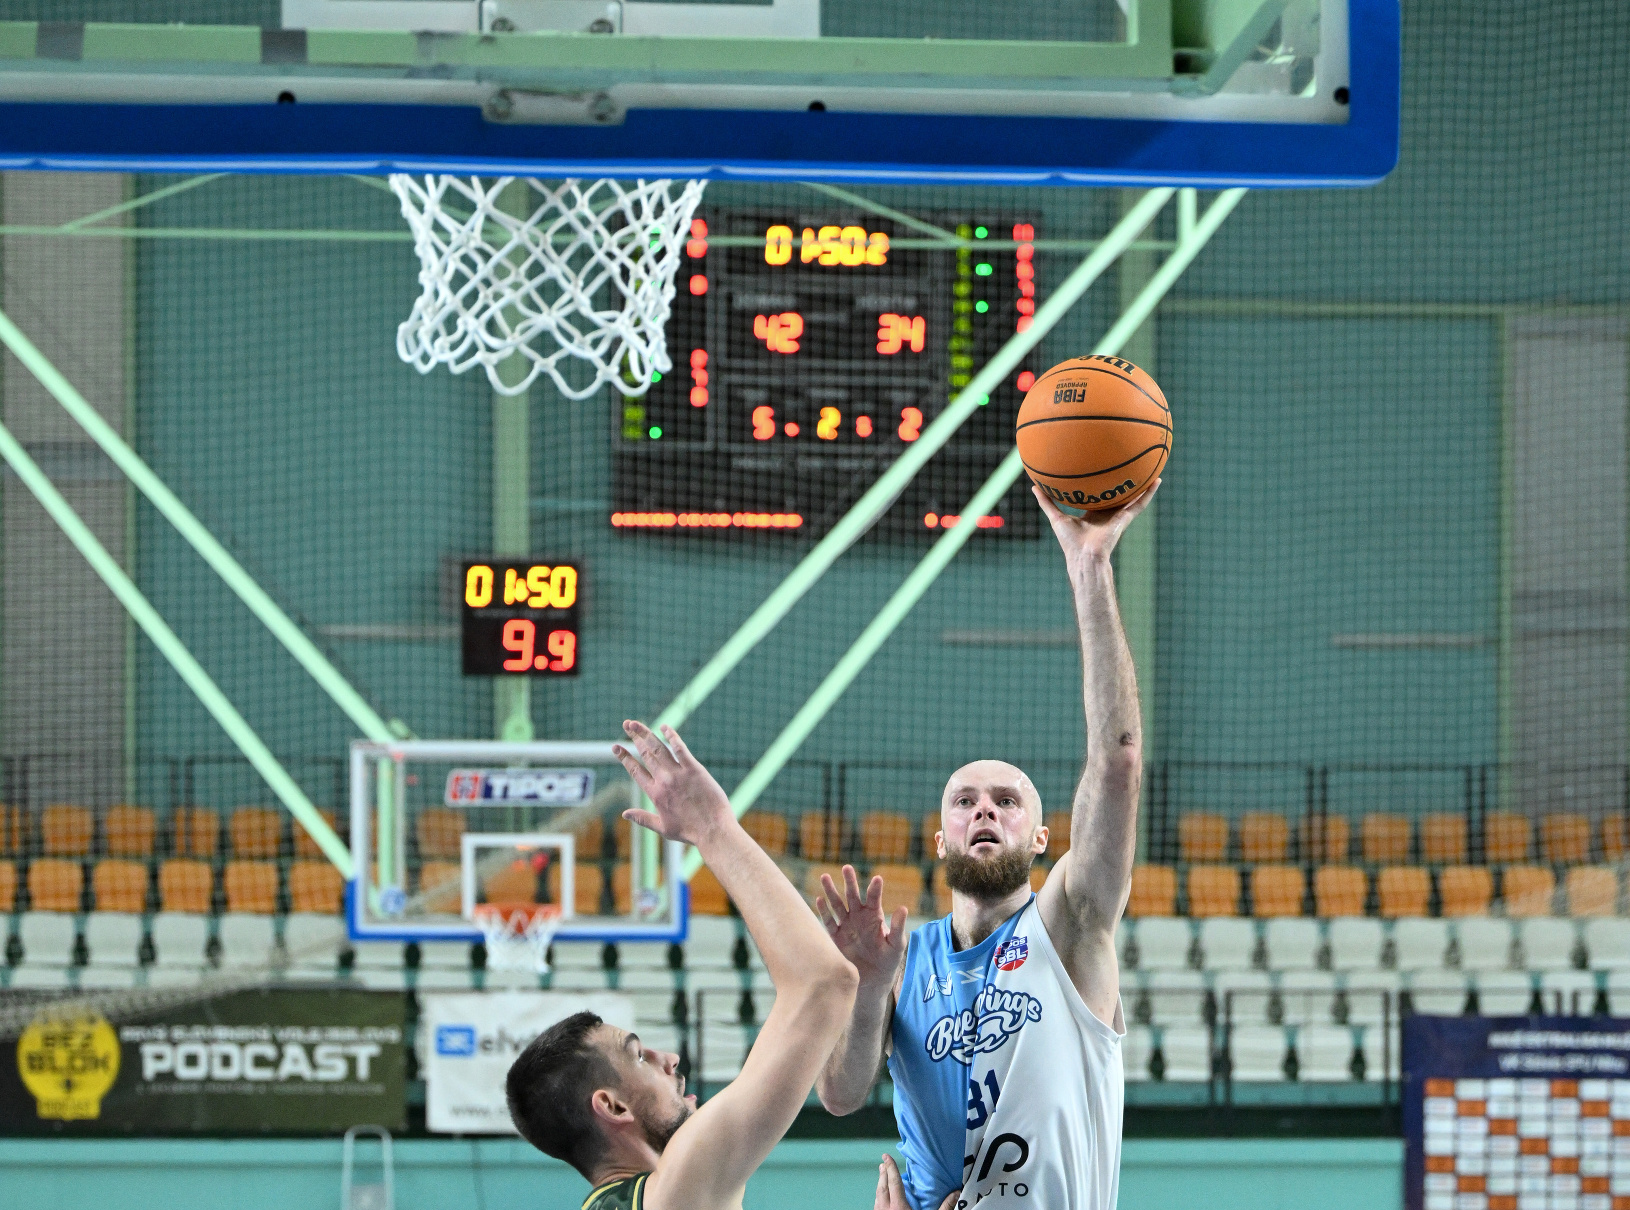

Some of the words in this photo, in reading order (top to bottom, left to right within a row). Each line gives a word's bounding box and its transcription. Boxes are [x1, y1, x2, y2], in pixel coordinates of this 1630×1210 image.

[753, 312, 804, 354] 42
[876, 313, 926, 355] 34
[1054, 389, 1086, 405] FIBA
[1035, 477, 1137, 505] Wilson
[502, 618, 577, 672] 9.9
[482, 774, 586, 799] TIPOS
[998, 947, 1027, 968] SBL
[140, 1042, 382, 1081] PODCAST
